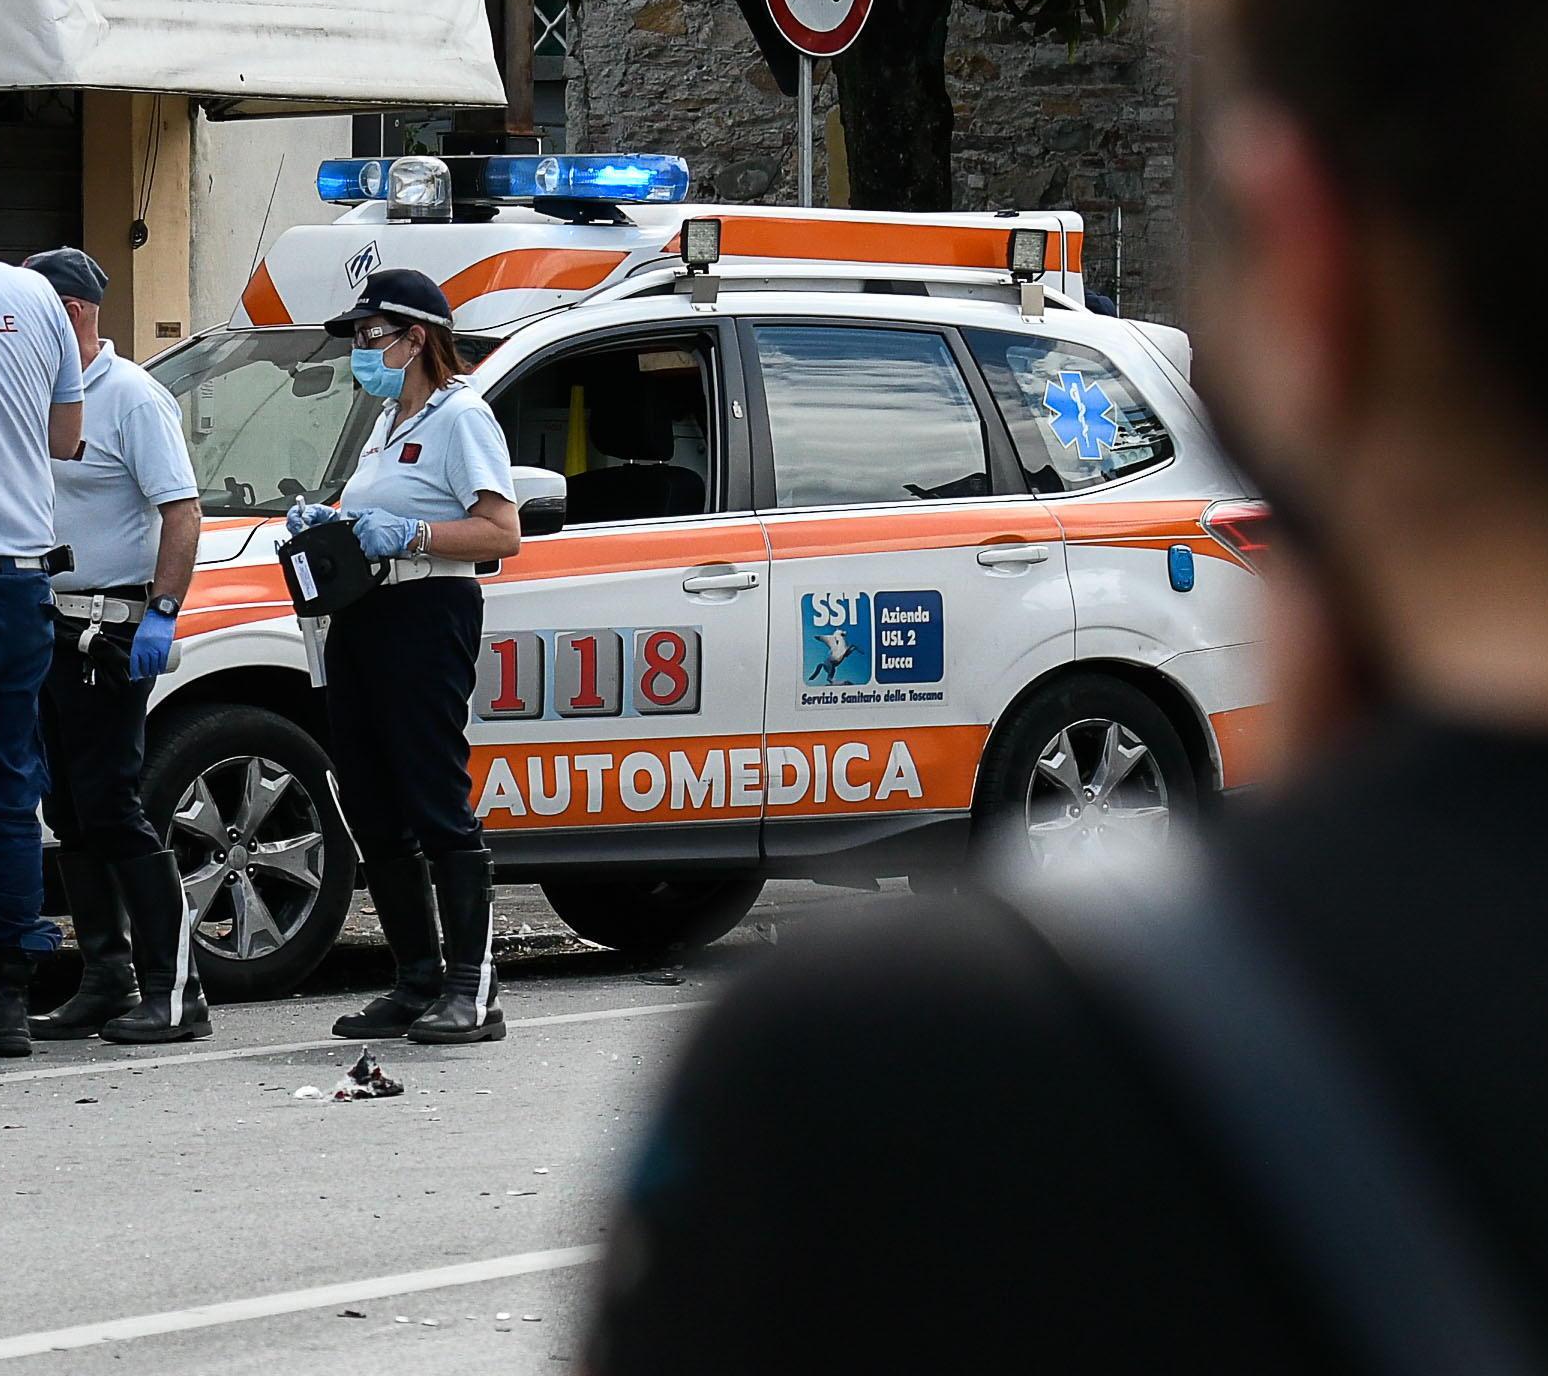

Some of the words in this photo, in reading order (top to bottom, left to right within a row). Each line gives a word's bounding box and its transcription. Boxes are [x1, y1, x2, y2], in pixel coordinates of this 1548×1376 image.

[811, 592, 861, 627] SST
[881, 605, 930, 624] Azienda
[881, 630, 905, 647] USL
[907, 629, 917, 646] 2
[490, 630, 691, 712] 118
[881, 653, 914, 670] Lucca
[801, 691, 839, 706] Servizio
[840, 690, 882, 705] Sanitario
[883, 688, 906, 703] della
[908, 689, 944, 702] Toscana
[473, 740, 924, 819] AUTOMEDICA
